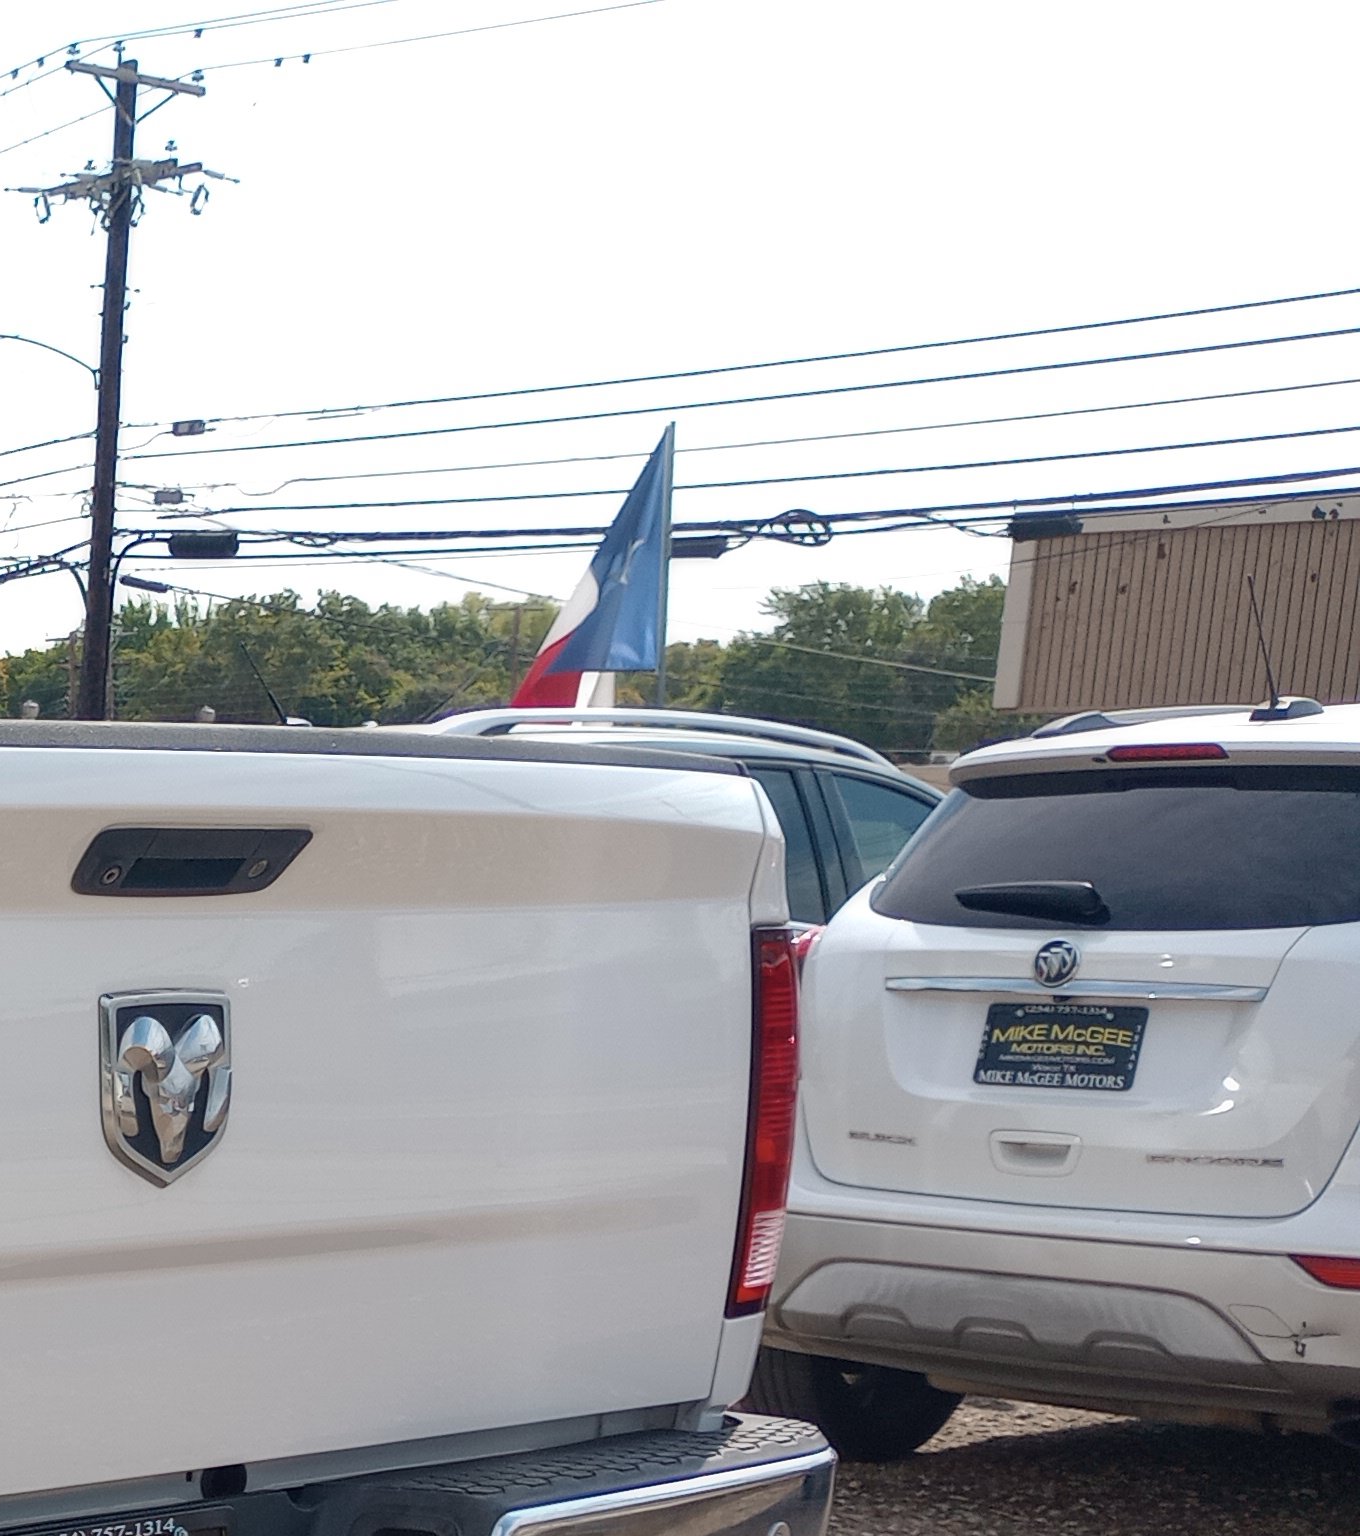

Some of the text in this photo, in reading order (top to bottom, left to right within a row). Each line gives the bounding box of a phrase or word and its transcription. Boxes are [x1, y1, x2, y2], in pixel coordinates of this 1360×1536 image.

[991, 1024, 1134, 1048] MIKE McGEE
[1010, 1043, 1075, 1055] MOTORS
[980, 1070, 1126, 1089] MIKE McGEE MOTORS
